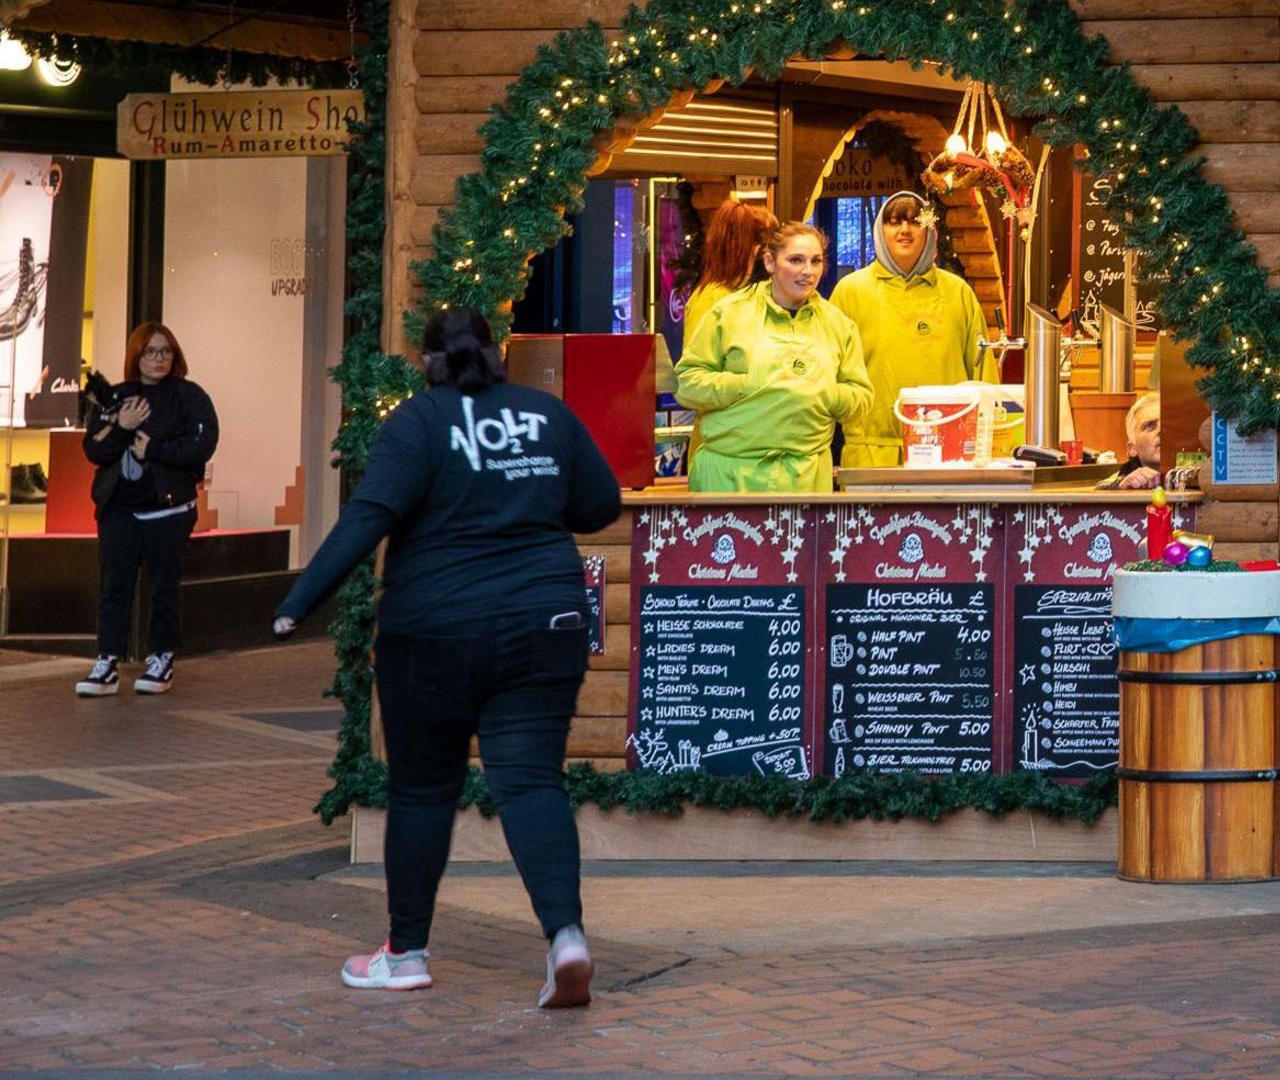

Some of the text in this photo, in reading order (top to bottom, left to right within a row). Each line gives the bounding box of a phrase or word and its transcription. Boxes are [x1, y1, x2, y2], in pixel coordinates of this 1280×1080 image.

[133, 99, 283, 141] Glühwein
[867, 588, 953, 608] HOFBRÄU
[657, 620, 691, 632] HEISSE
[768, 619, 801, 637] 4.00
[871, 625, 992, 644] HALF PINT 4.00
[700, 644, 736, 657] DREAM
[768, 638, 801, 656] 6.00
[870, 646, 899, 661] PINT
[657, 661, 801, 680] MEN'S DREAM 6.00
[868, 663, 911, 677] DOUBLE
[912, 663, 941, 676] PINT
[656, 682, 801, 700] SANTA'S DREAM 6.00
[867, 691, 926, 705] WEISSBIER
[928, 689, 954, 705] PINT
[655, 703, 801, 722] HUNTER'S DREAM 6.00
[865, 719, 991, 737] SHANDY PINT 5.00
[960, 758, 992, 772] 5.00
